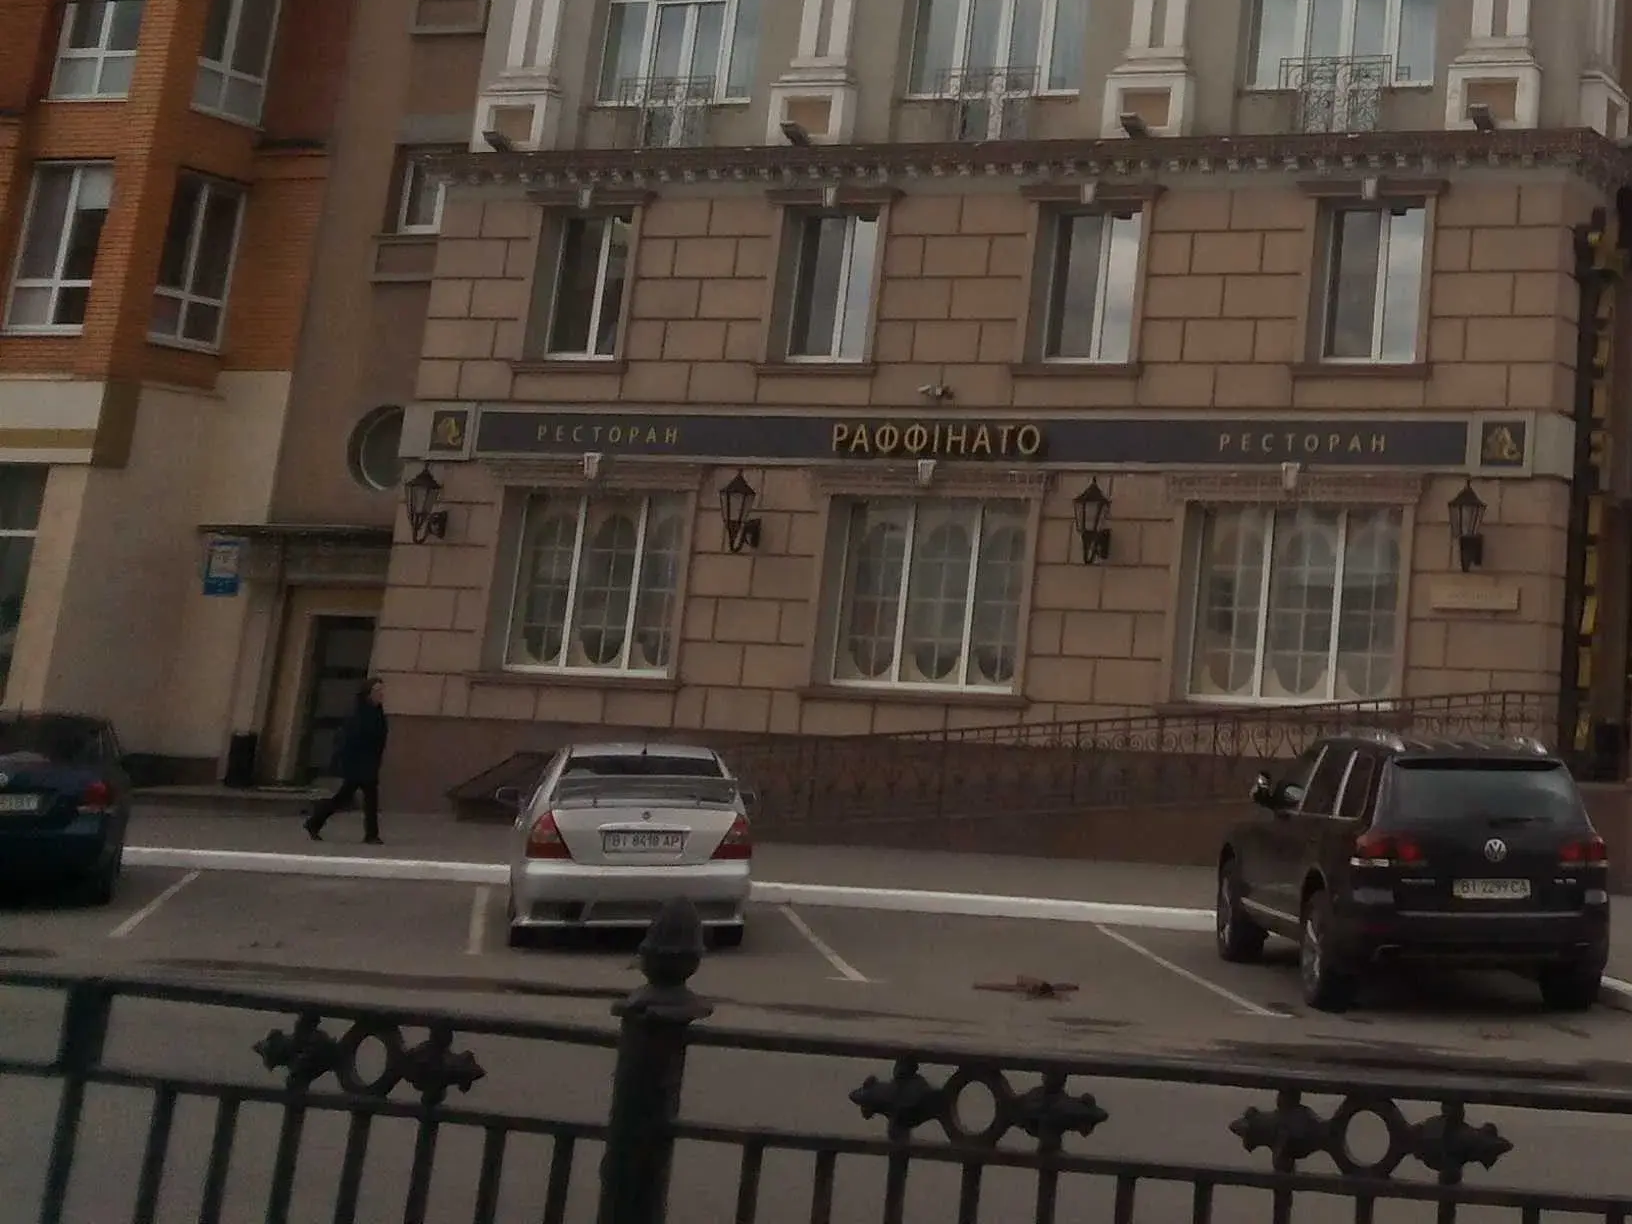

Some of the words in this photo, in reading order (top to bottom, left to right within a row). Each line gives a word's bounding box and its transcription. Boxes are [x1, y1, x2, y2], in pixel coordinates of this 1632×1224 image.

[536, 424, 681, 445] РЕСТОРАН
[831, 422, 1041, 455] РАФФІНАТО
[1219, 433, 1386, 453] РЕСТОРАН
